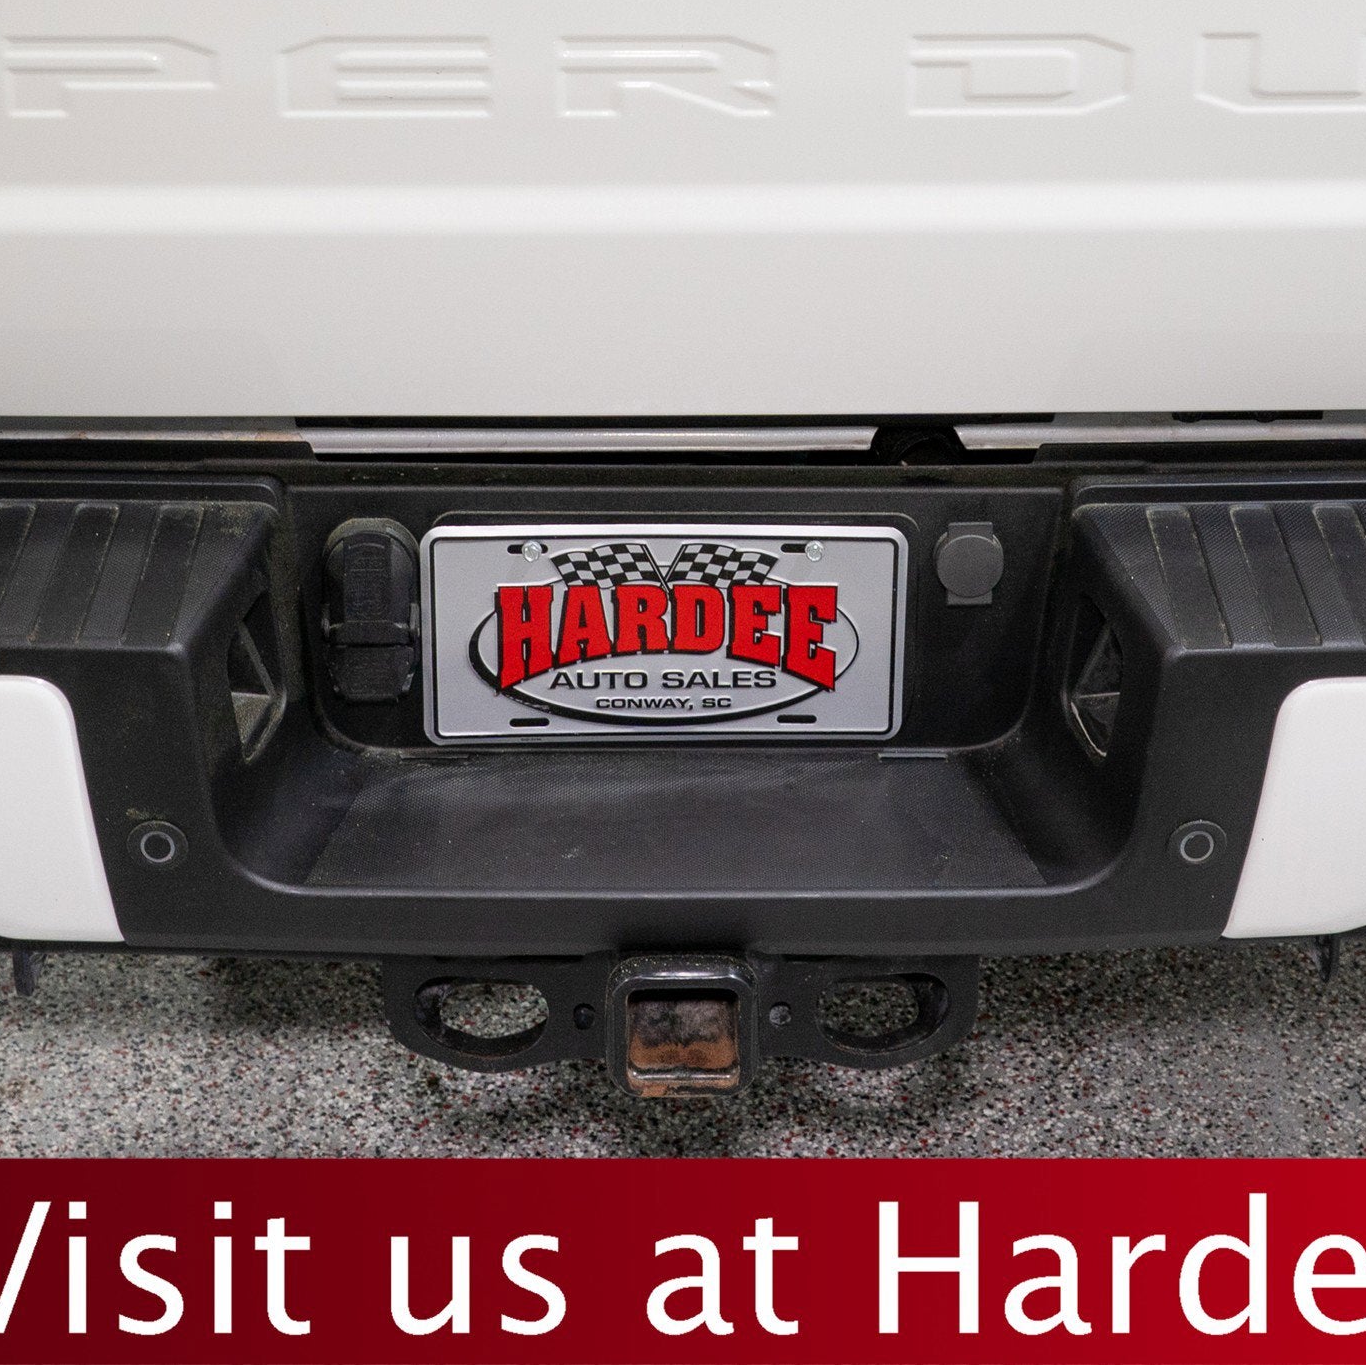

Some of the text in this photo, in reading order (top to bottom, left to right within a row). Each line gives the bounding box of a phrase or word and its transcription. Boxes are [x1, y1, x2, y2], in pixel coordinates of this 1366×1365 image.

[494, 584, 838, 691] HARDEE
[549, 670, 777, 690] AUTO SALES
[595, 697, 732, 711] CONWAY, SC
